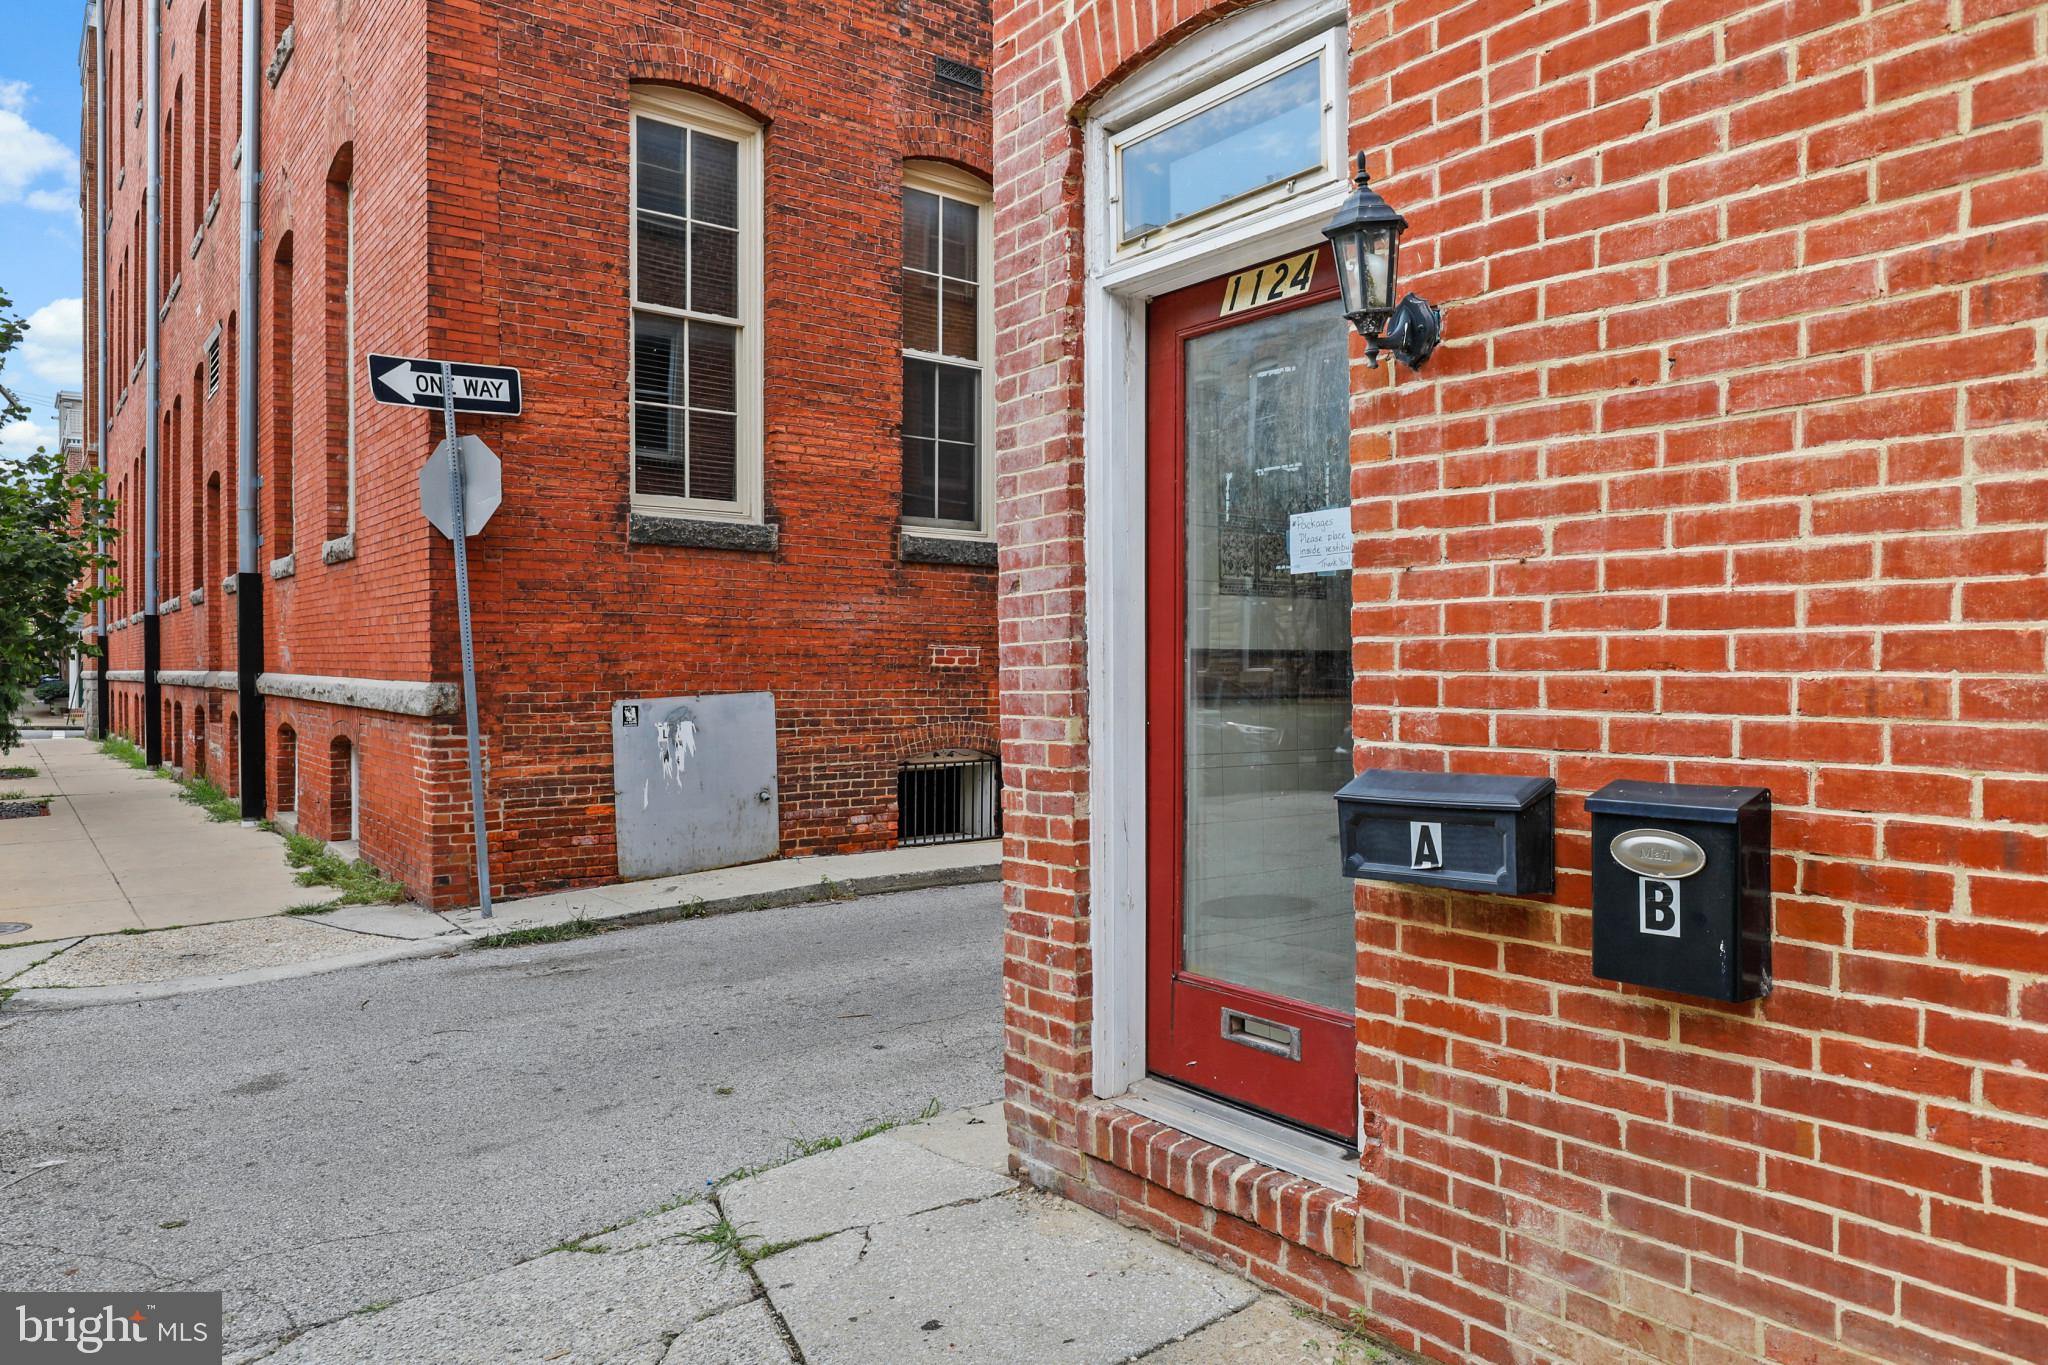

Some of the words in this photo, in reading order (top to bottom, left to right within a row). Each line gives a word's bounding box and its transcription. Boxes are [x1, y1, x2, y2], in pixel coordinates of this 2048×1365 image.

[1229, 253, 1314, 311] 1124
[463, 378, 503, 398] WAY
[1299, 533, 1322, 544] Please
[1327, 531, 1346, 542] place
[1413, 824, 1440, 867] A
[1640, 846, 1672, 862] Mail
[1644, 879, 1676, 931] B
